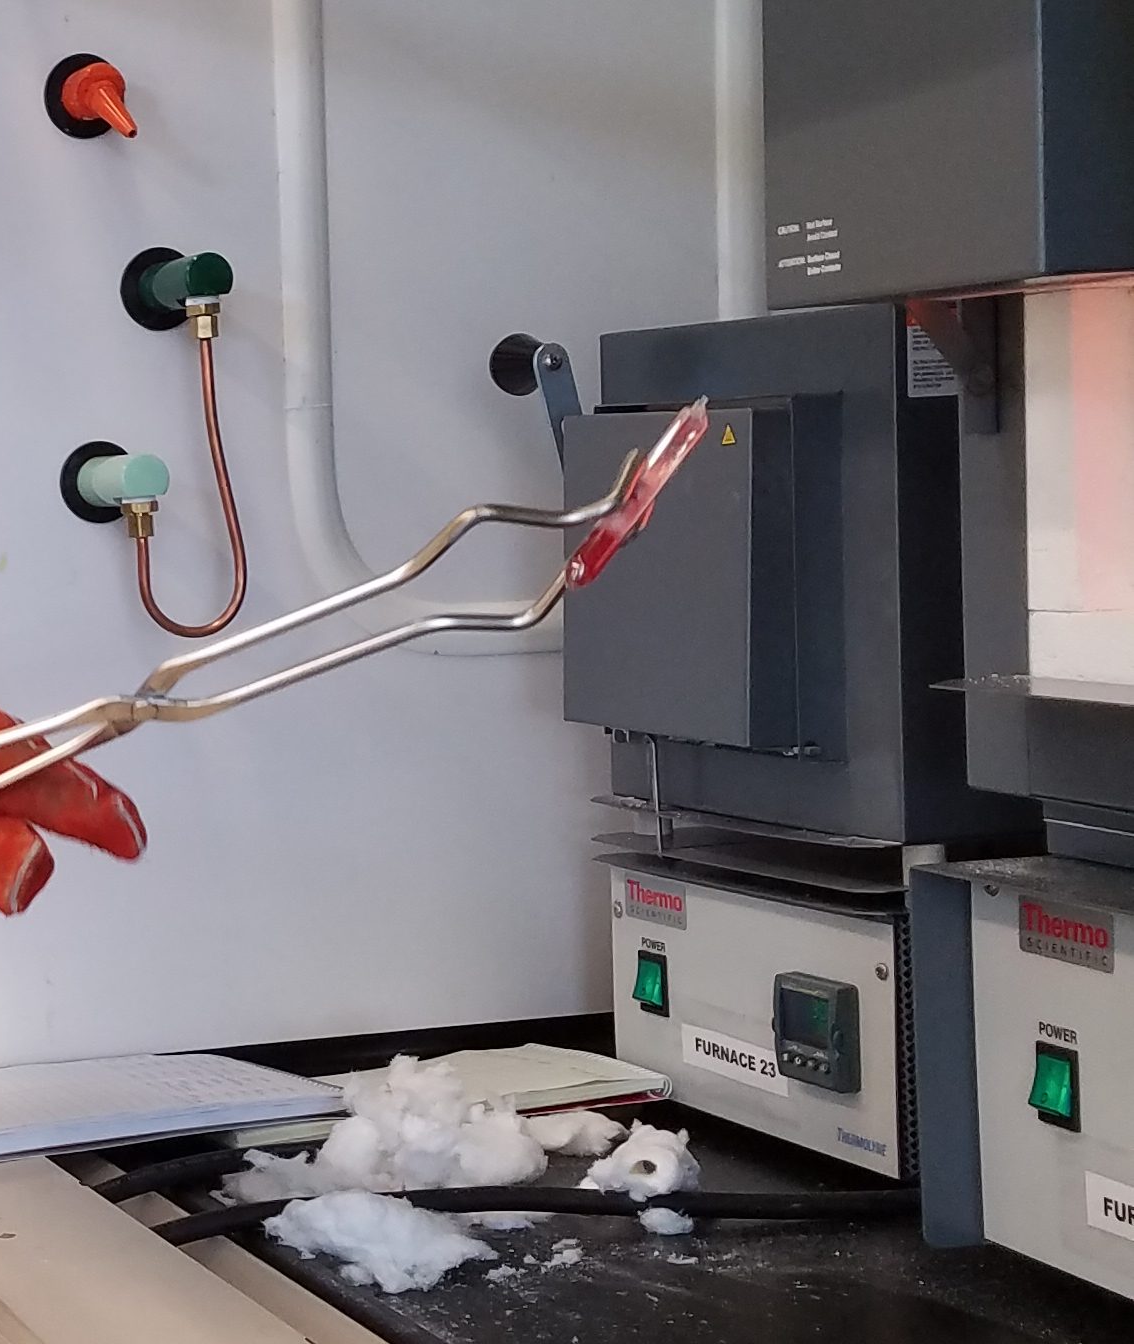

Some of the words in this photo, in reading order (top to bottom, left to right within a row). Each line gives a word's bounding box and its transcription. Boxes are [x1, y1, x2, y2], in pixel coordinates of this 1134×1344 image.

[627, 879, 683, 912] Thermo
[1021, 902, 1109, 949] Thermo
[642, 937, 665, 952] POWER
[1027, 937, 1107, 966] SCIENTIFIC
[1038, 1021, 1079, 1045] POWER
[695, 1037, 756, 1071] FURNACE
[760, 1059, 776, 1077] 23
